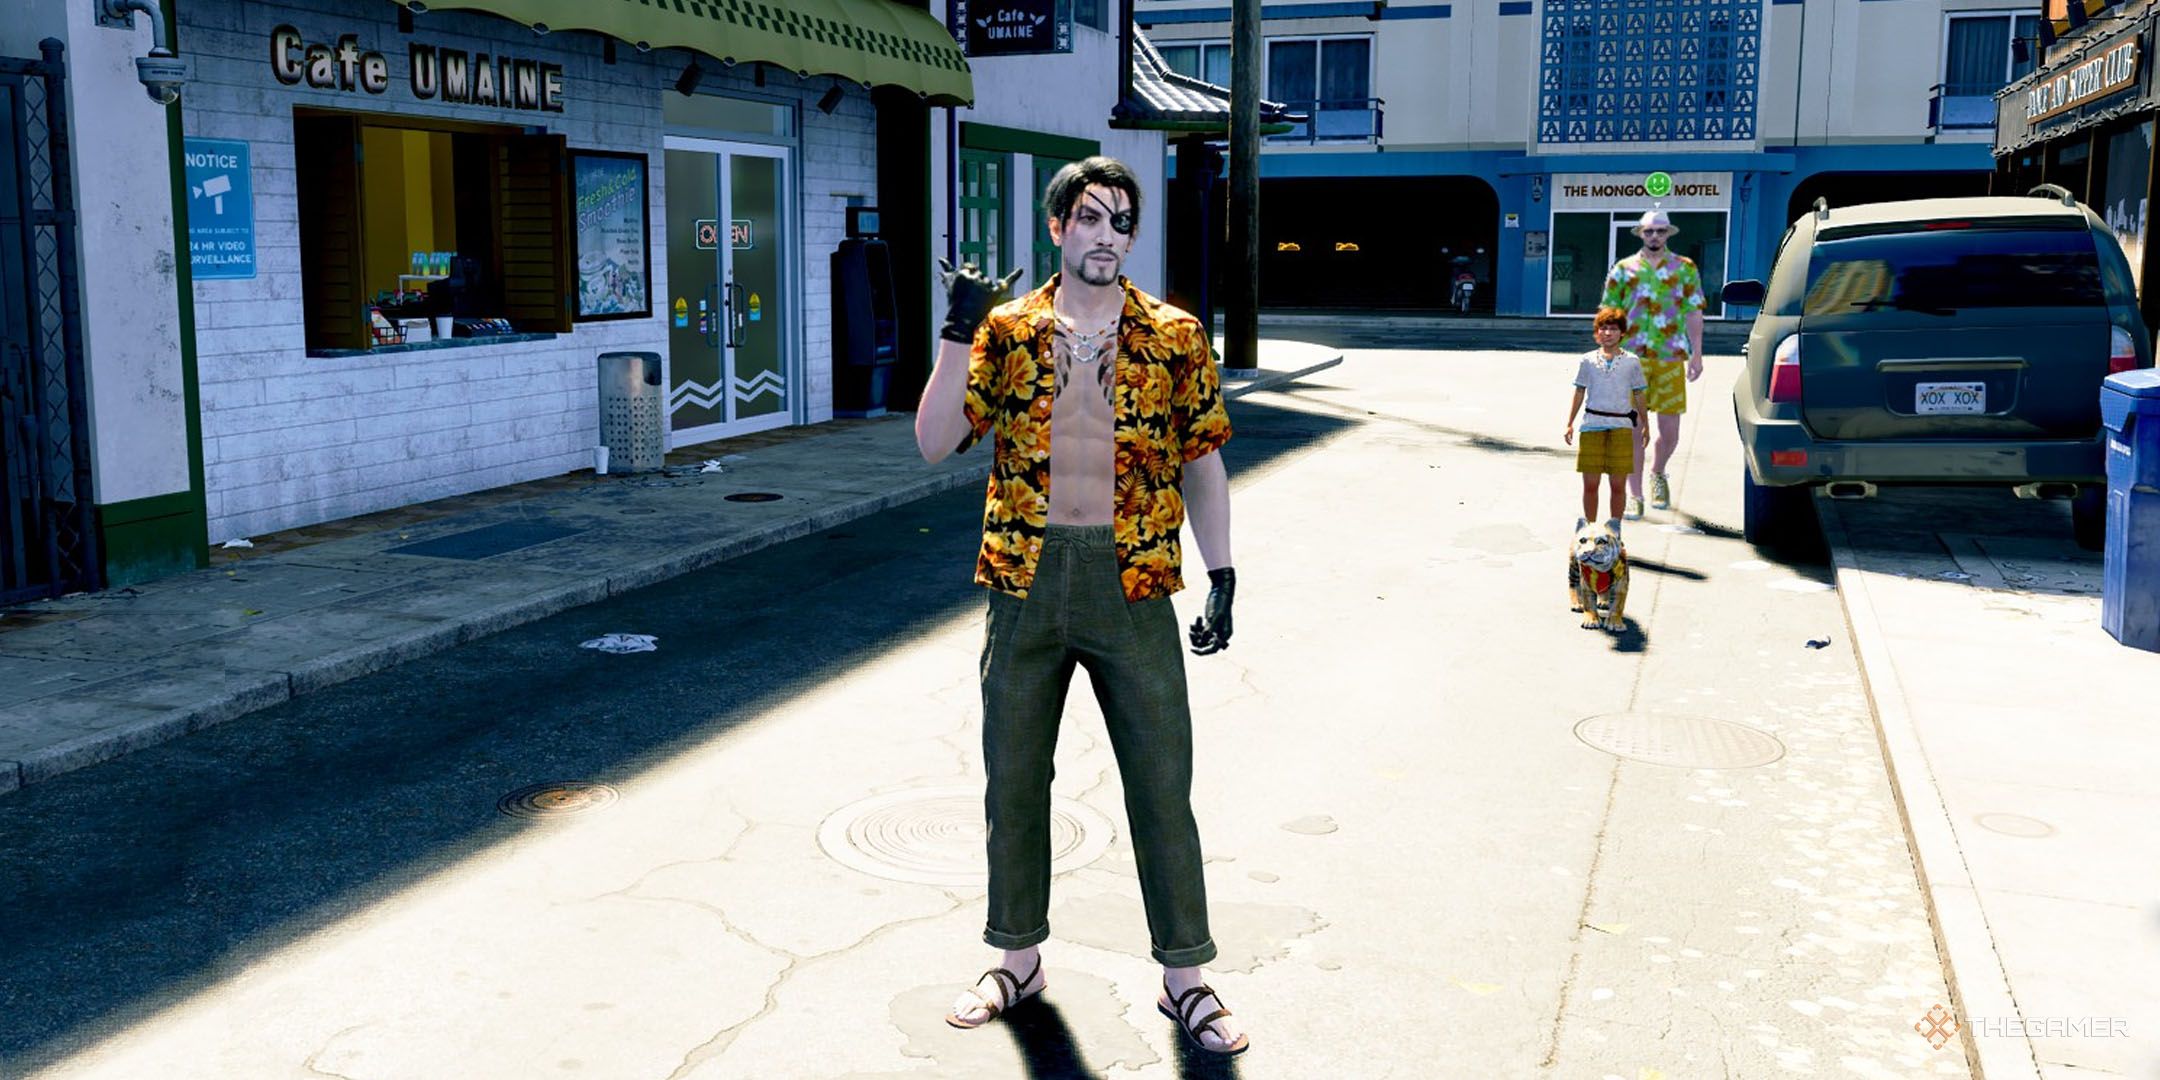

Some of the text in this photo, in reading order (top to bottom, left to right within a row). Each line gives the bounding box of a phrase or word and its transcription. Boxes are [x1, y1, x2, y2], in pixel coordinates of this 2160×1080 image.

[997, 9, 1025, 22] Cafe
[988, 25, 1033, 39] UMAINE
[270, 24, 563, 113] Cafe UMAINE
[2050, 75, 2068, 110] AND
[2068, 57, 2104, 103] SUPPER
[2105, 42, 2134, 88] CLUB
[185, 152, 237, 168] NOTICE
[1563, 185, 1587, 197] THE
[1675, 184, 1720, 196] MOTEL
[579, 187, 636, 233] Smoothie
[700, 224, 749, 243] OEN
[202, 241, 215, 251] HR
[218, 241, 246, 251] VIDEO
[1921, 391, 1979, 405] XOX XOX
